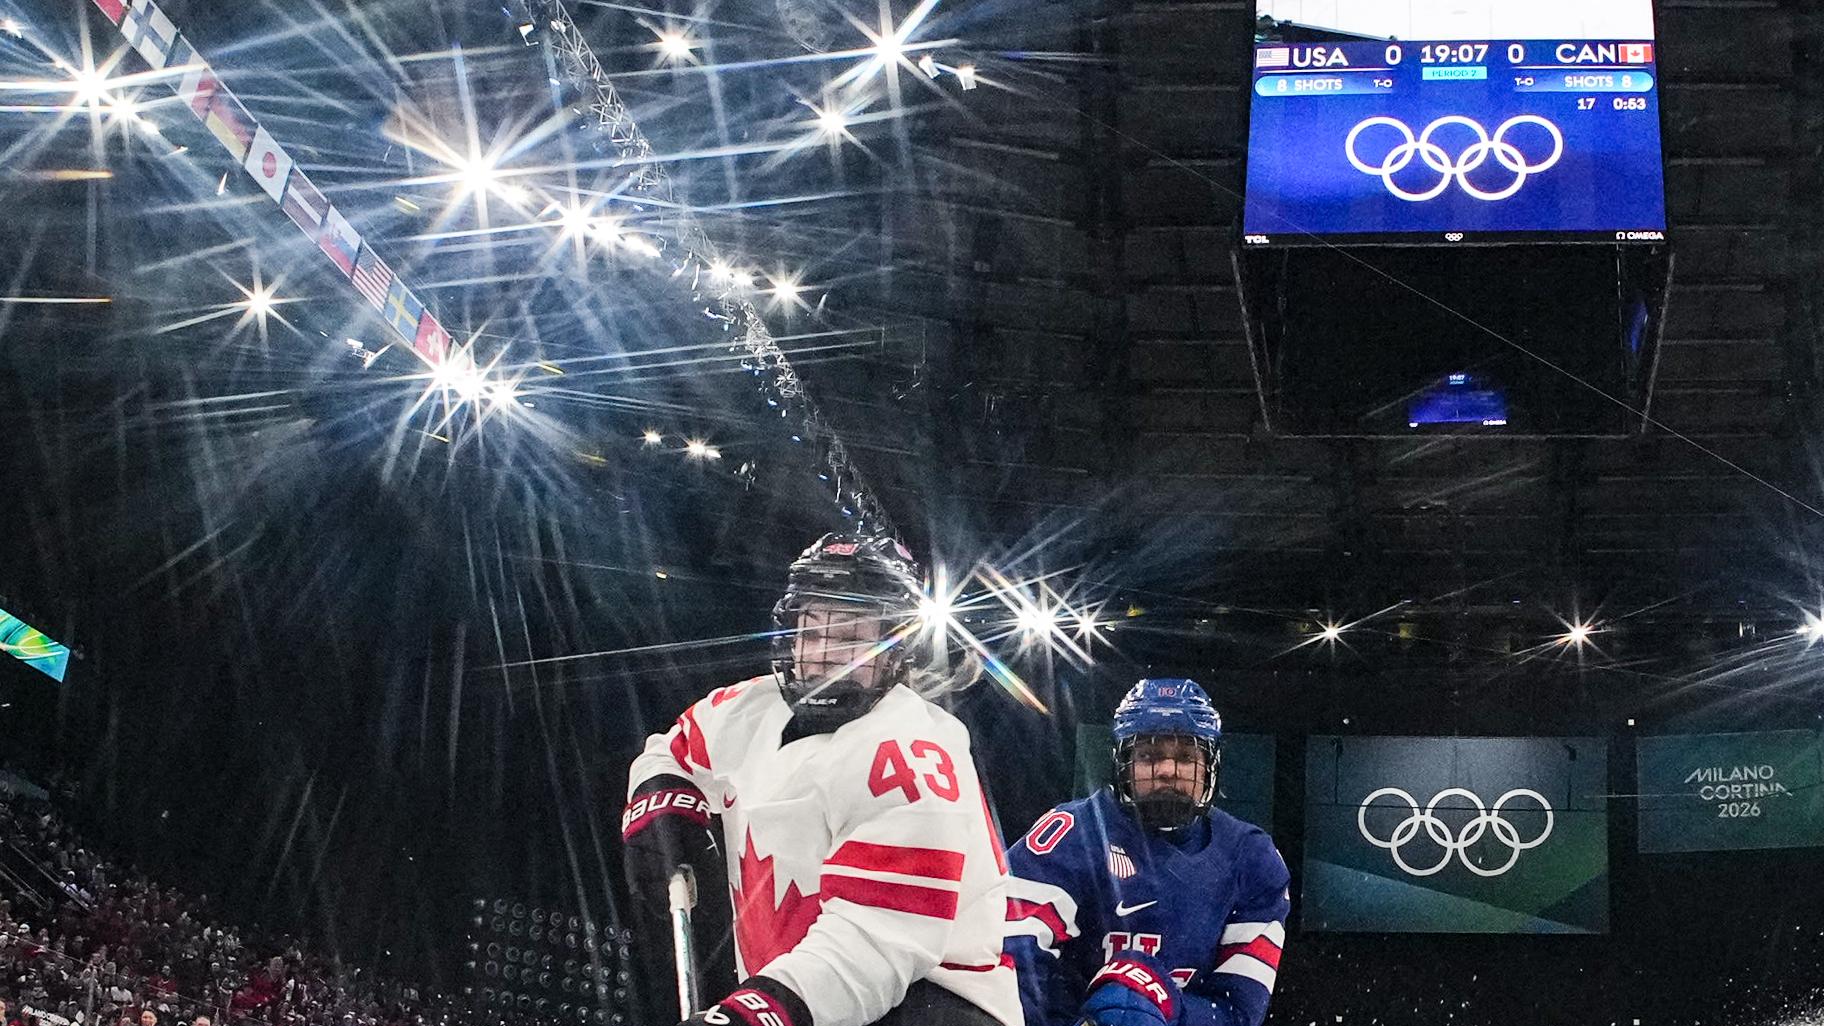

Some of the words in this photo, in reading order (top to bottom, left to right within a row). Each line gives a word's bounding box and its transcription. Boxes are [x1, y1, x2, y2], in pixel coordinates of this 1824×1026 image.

[1293, 47, 1349, 68] USA
[1385, 44, 1402, 66] 0
[1420, 44, 1489, 64] 19:07
[1507, 43, 1524, 64] 0
[1555, 43, 1616, 64] CAN
[1276, 79, 1287, 92] 8
[1294, 78, 1342, 91] SHOTS
[1564, 75, 1613, 88] SHOTS
[1621, 75, 1632, 88] 8
[1577, 98, 1596, 110] 17
[1245, 235, 1269, 244] TCL
[1627, 231, 1664, 240] OMEGA
[868, 739, 960, 803] 43
[1684, 765, 1774, 784] MILANO
[1700, 782, 1793, 800] CORTINA
[1718, 802, 1761, 818] 2026
[1086, 961, 1168, 1005] UER
